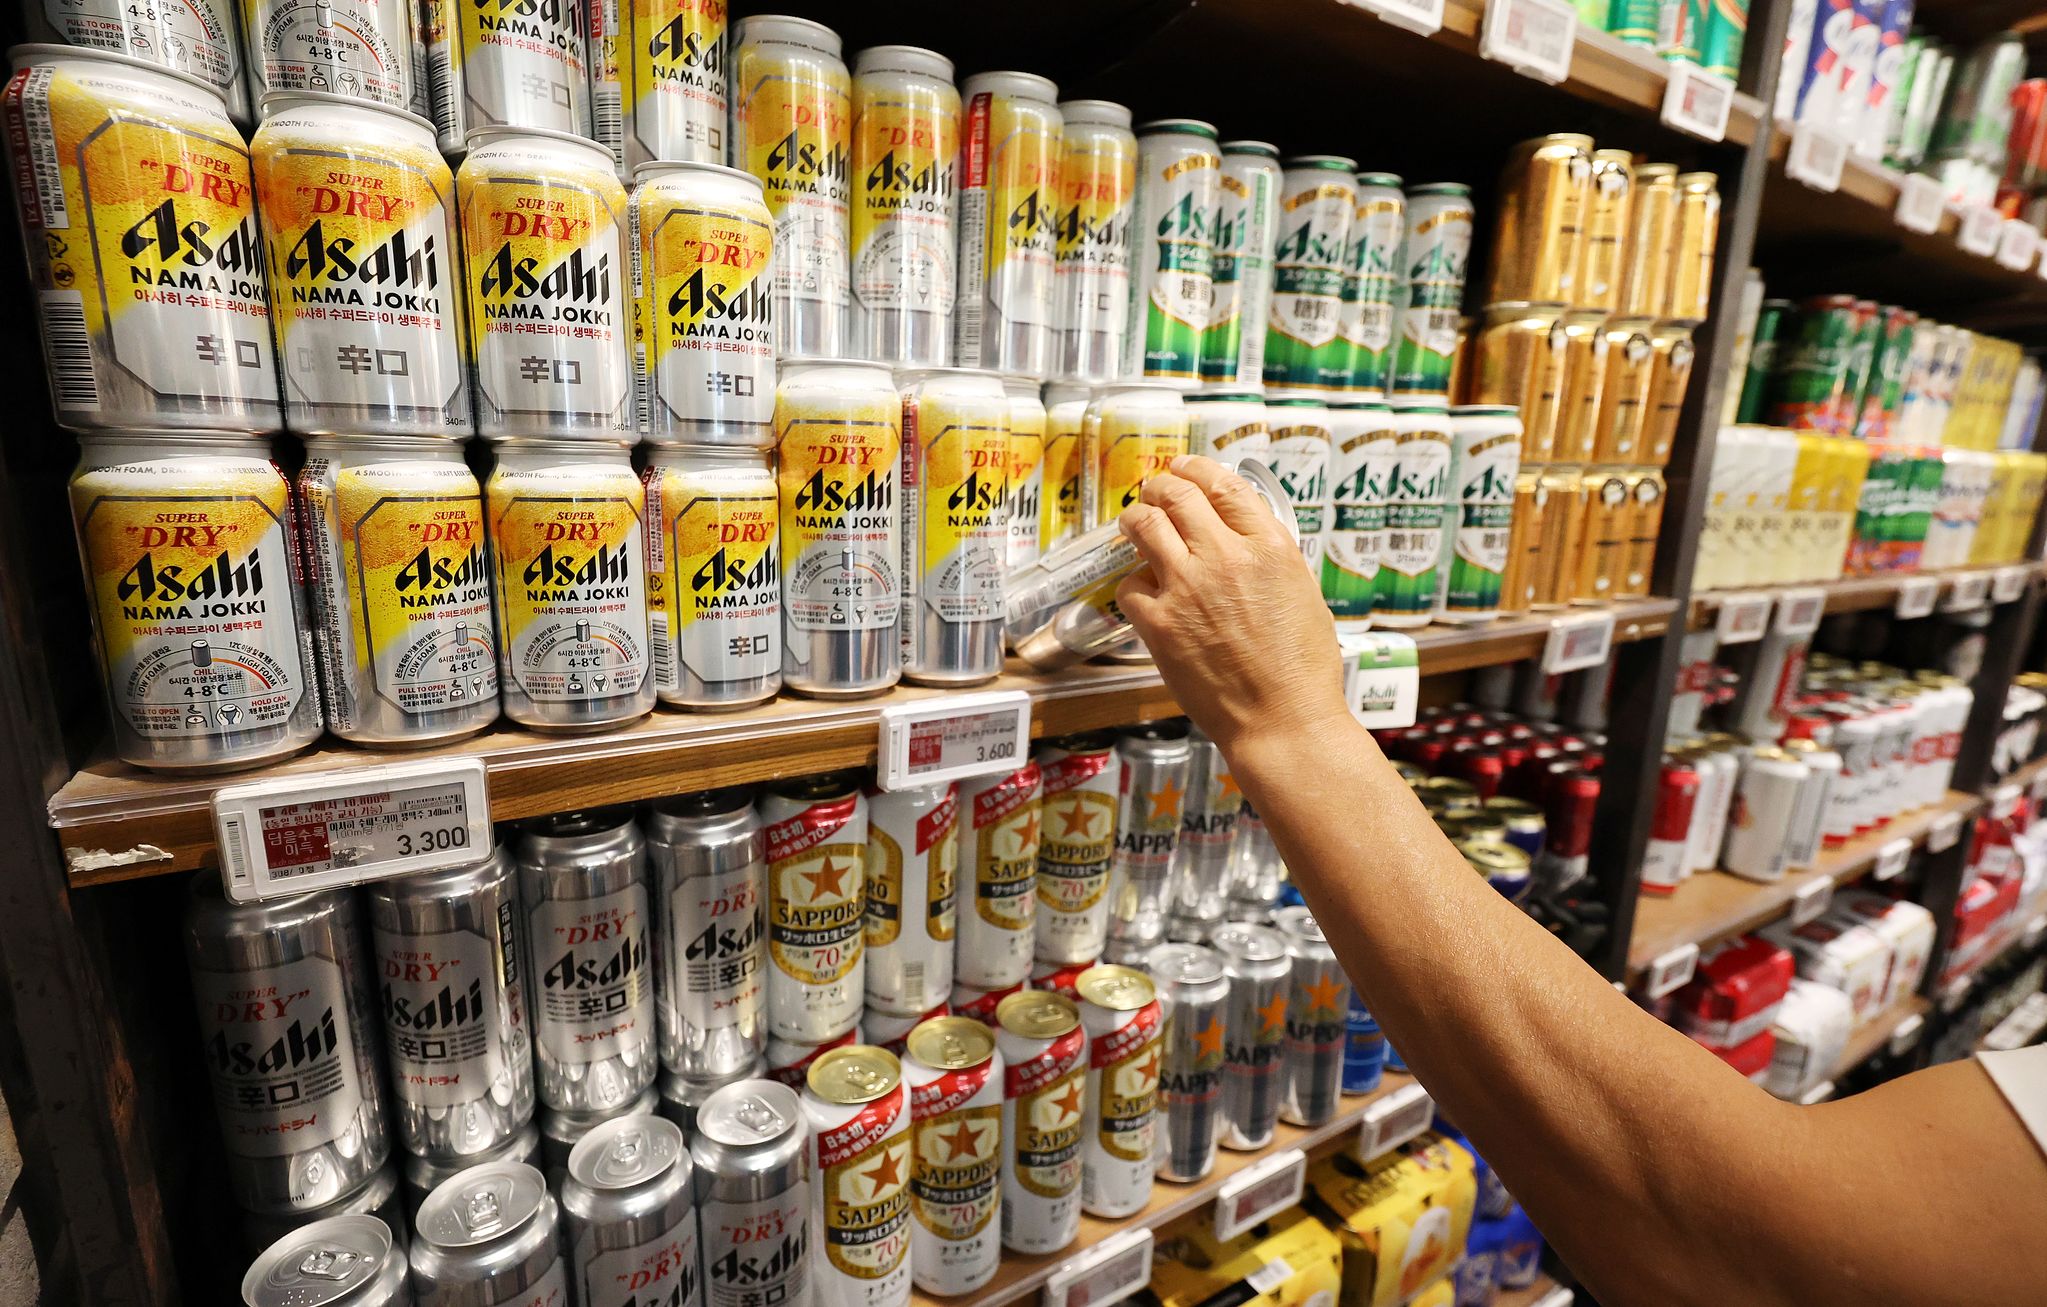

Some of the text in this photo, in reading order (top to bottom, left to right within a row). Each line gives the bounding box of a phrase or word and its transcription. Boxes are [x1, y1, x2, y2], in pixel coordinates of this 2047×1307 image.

[65, 19, 123, 31] PULL TO OPEN
[270, 16, 294, 53] LOW FOAM
[479, 15, 542, 39] NAMA
[315, 37, 329, 45] 이상
[346, 42, 360, 51] 보관
[480, 34, 512, 47] 아사히
[214, 52, 226, 61] CAN
[653, 65, 704, 88] NAMA
[9, 113, 39, 223] 미만 판매금지
[181, 150, 232, 175] SUPER
[327, 172, 384, 190] SUPER
[767, 177, 818, 194] NAMA
[867, 150, 953, 199] Asahi
[296, 186, 415, 222] “DRY”
[516, 197, 565, 212] SUPER
[866, 197, 912, 209] NAMA
[491, 211, 591, 241] “DRY”
[710, 230, 749, 243] SUPER
[286, 219, 438, 291] Asahi
[130, 266, 222, 293] NAMA
[481, 241, 610, 306] Asahi
[133, 289, 248, 316] 아사히 수퍼드라이
[293, 286, 440, 315] NAMA JOKKI
[669, 267, 772, 326] Asahi
[295, 308, 442, 330] 아사히 수퍼드라이 생맥주캔
[485, 304, 611, 327] NAMA JOKKI
[486, 323, 570, 338] 아사히 수퍼드라이
[671, 322, 772, 345] NAMA JOKKI
[195, 334, 261, 369] 辛口
[672, 339, 749, 355] 아사히 수퍼드라이
[337, 344, 409, 376] 辛口
[520, 356, 582, 384] 辛口
[706, 371, 754, 397] 辛口
[446, 417, 467, 427] 340ml
[830, 434, 866, 444] SUPER
[808, 446, 883, 465] “DRY”
[124, 466, 157, 475] FOAM,
[795, 467, 892, 512] Asahi
[155, 514, 208, 523] SUPER
[434, 511, 466, 520] SUPER
[557, 512, 595, 520] SUPER
[731, 512, 764, 521] SUPER
[796, 515, 893, 529] NAMA JOKKI
[949, 515, 991, 527] NAMA
[125, 525, 239, 548] “DRY”
[534, 522, 615, 541] “DRY”
[117, 548, 263, 602] Asahi
[523, 542, 628, 586] Asahi
[400, 592, 458, 608] NAMA
[527, 586, 629, 601] NAMA JOKKI
[695, 595, 748, 609] NAMA
[123, 600, 266, 620] NAMA JOKKI
[408, 607, 473, 621] 아사히 수퍼드라이
[533, 603, 626, 615] 아사히 수퍼드라이 생맥주캔
[696, 609, 764, 621] 아사히 수퍼드라이
[133, 620, 263, 636] 아사히 수퍼드라이 생맥주캔
[329, 605, 347, 686] 원산지: Asahi
[532, 637, 557, 666] LOW FOAM
[608, 633, 633, 660] HIGH FOAM
[729, 634, 769, 658] 辛口
[238, 656, 278, 686] HIGH FOAM
[408, 643, 438, 678] LOW FOAM
[449, 660, 477, 674] 4-8°C
[568, 657, 600, 668] 4-8°C
[137, 663, 167, 697] LOW FOAM
[169, 673, 242, 685] 6시간 이상 보관
[184, 684, 229, 697] 4-8°C
[770, 820, 804, 845] 日本初
[1061, 880, 1084, 898] 70
[579, 908, 619, 924] SUPER
[393, 950, 432, 961] SUPER
[544, 926, 647, 990] Asahi
[813, 946, 840, 969] 70
[719, 956, 756, 983] 辛口
[227, 986, 277, 1000] SUPER
[578, 989, 627, 1016] 辛口
[207, 1006, 337, 1075] Asahi
[399, 1037, 447, 1059] 辛口
[825, 1121, 865, 1149] 日本初
[743, 1209, 780, 1225] SUPER
[950, 1206, 976, 1226] 70
[711, 1218, 807, 1285] Asahi
[875, 1236, 898, 1263] 70
